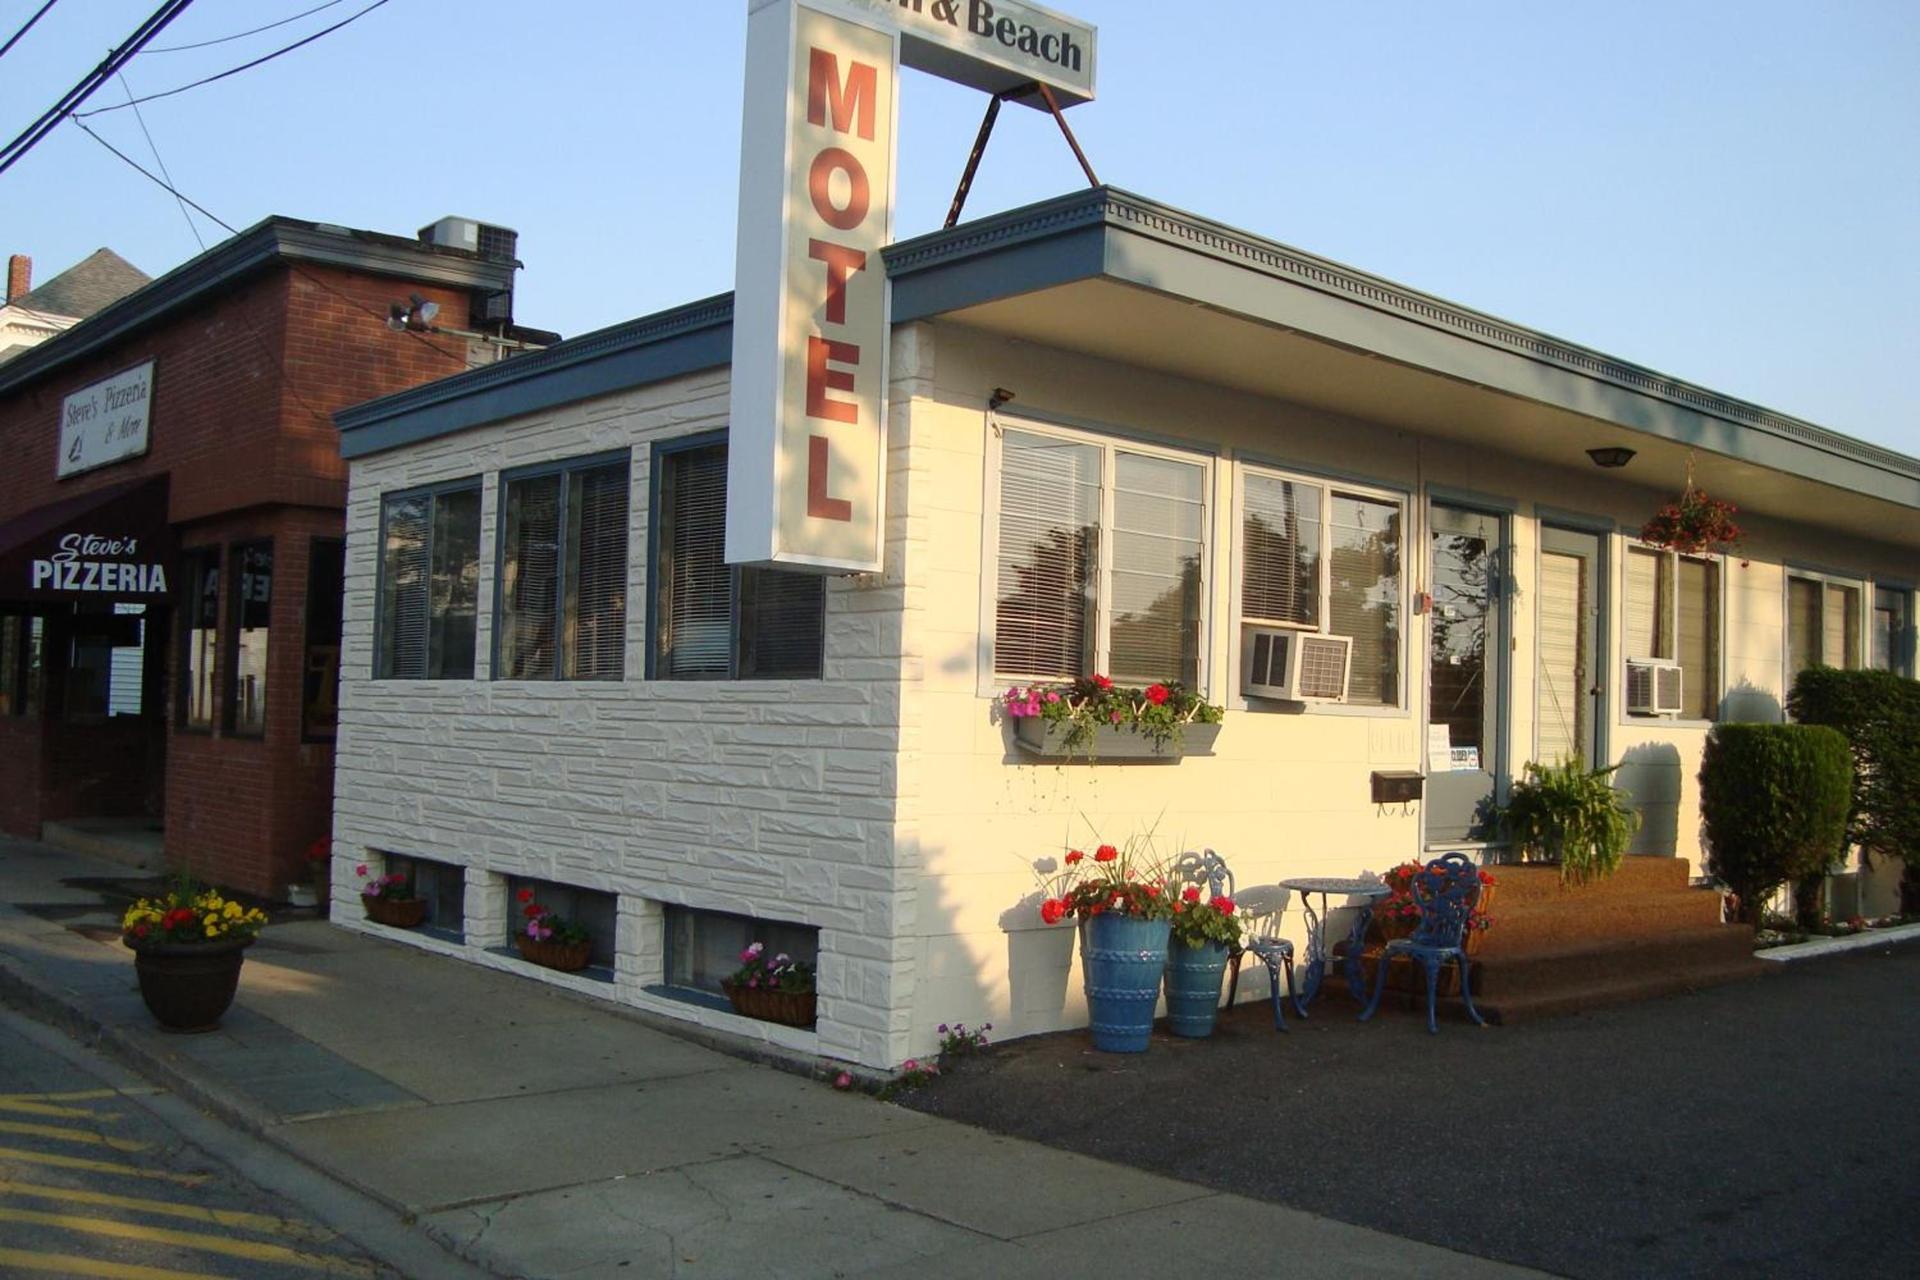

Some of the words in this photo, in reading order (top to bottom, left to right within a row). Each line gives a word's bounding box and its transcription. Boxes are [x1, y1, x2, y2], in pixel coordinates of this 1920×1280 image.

[931, 0, 959, 27] &
[967, 0, 1081, 72] Beach
[806, 46, 877, 522] MOTEL
[66, 395, 98, 427] Steve's
[104, 374, 146, 413] Pizzeria
[51, 533, 138, 563] Steve's
[33, 560, 167, 592] PIZZERIA
